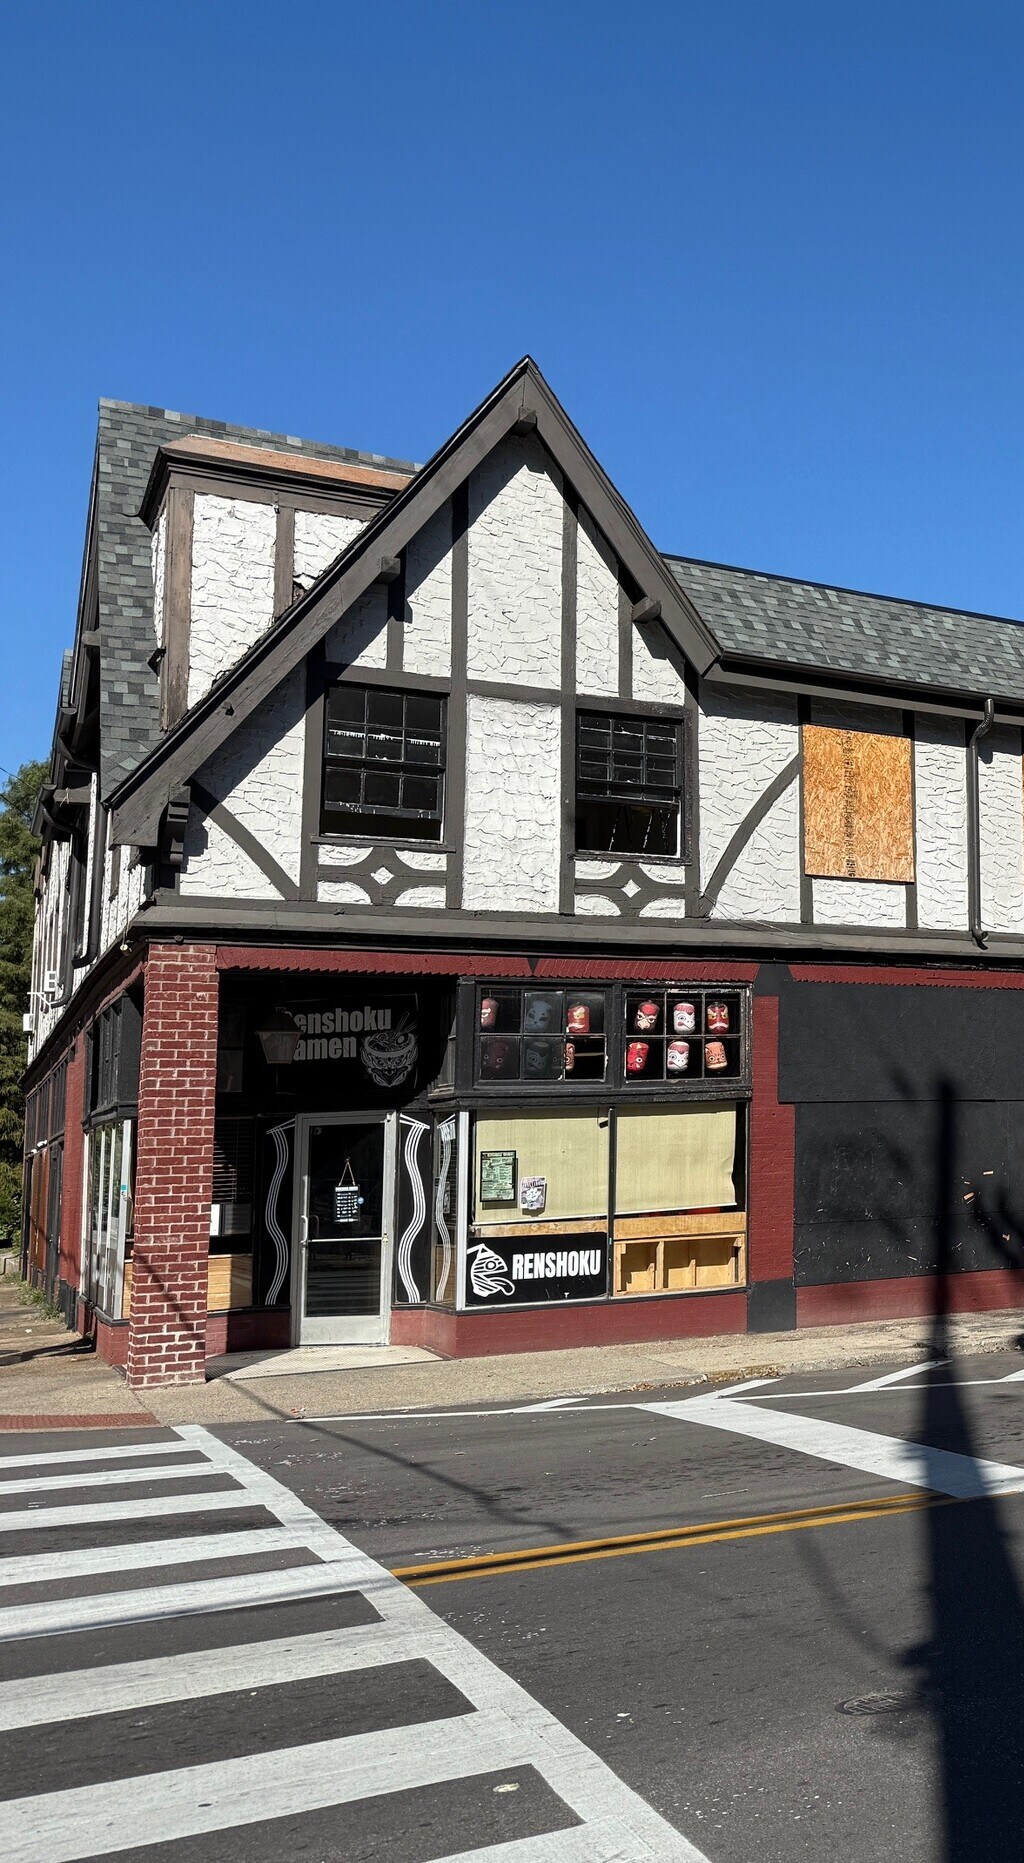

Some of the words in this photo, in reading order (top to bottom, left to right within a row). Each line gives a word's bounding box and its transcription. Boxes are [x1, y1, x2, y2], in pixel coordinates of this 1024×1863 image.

[285, 1006, 392, 1034] enshoku
[292, 1036, 357, 1061] amen
[512, 1249, 602, 1280] RENSHOKU
